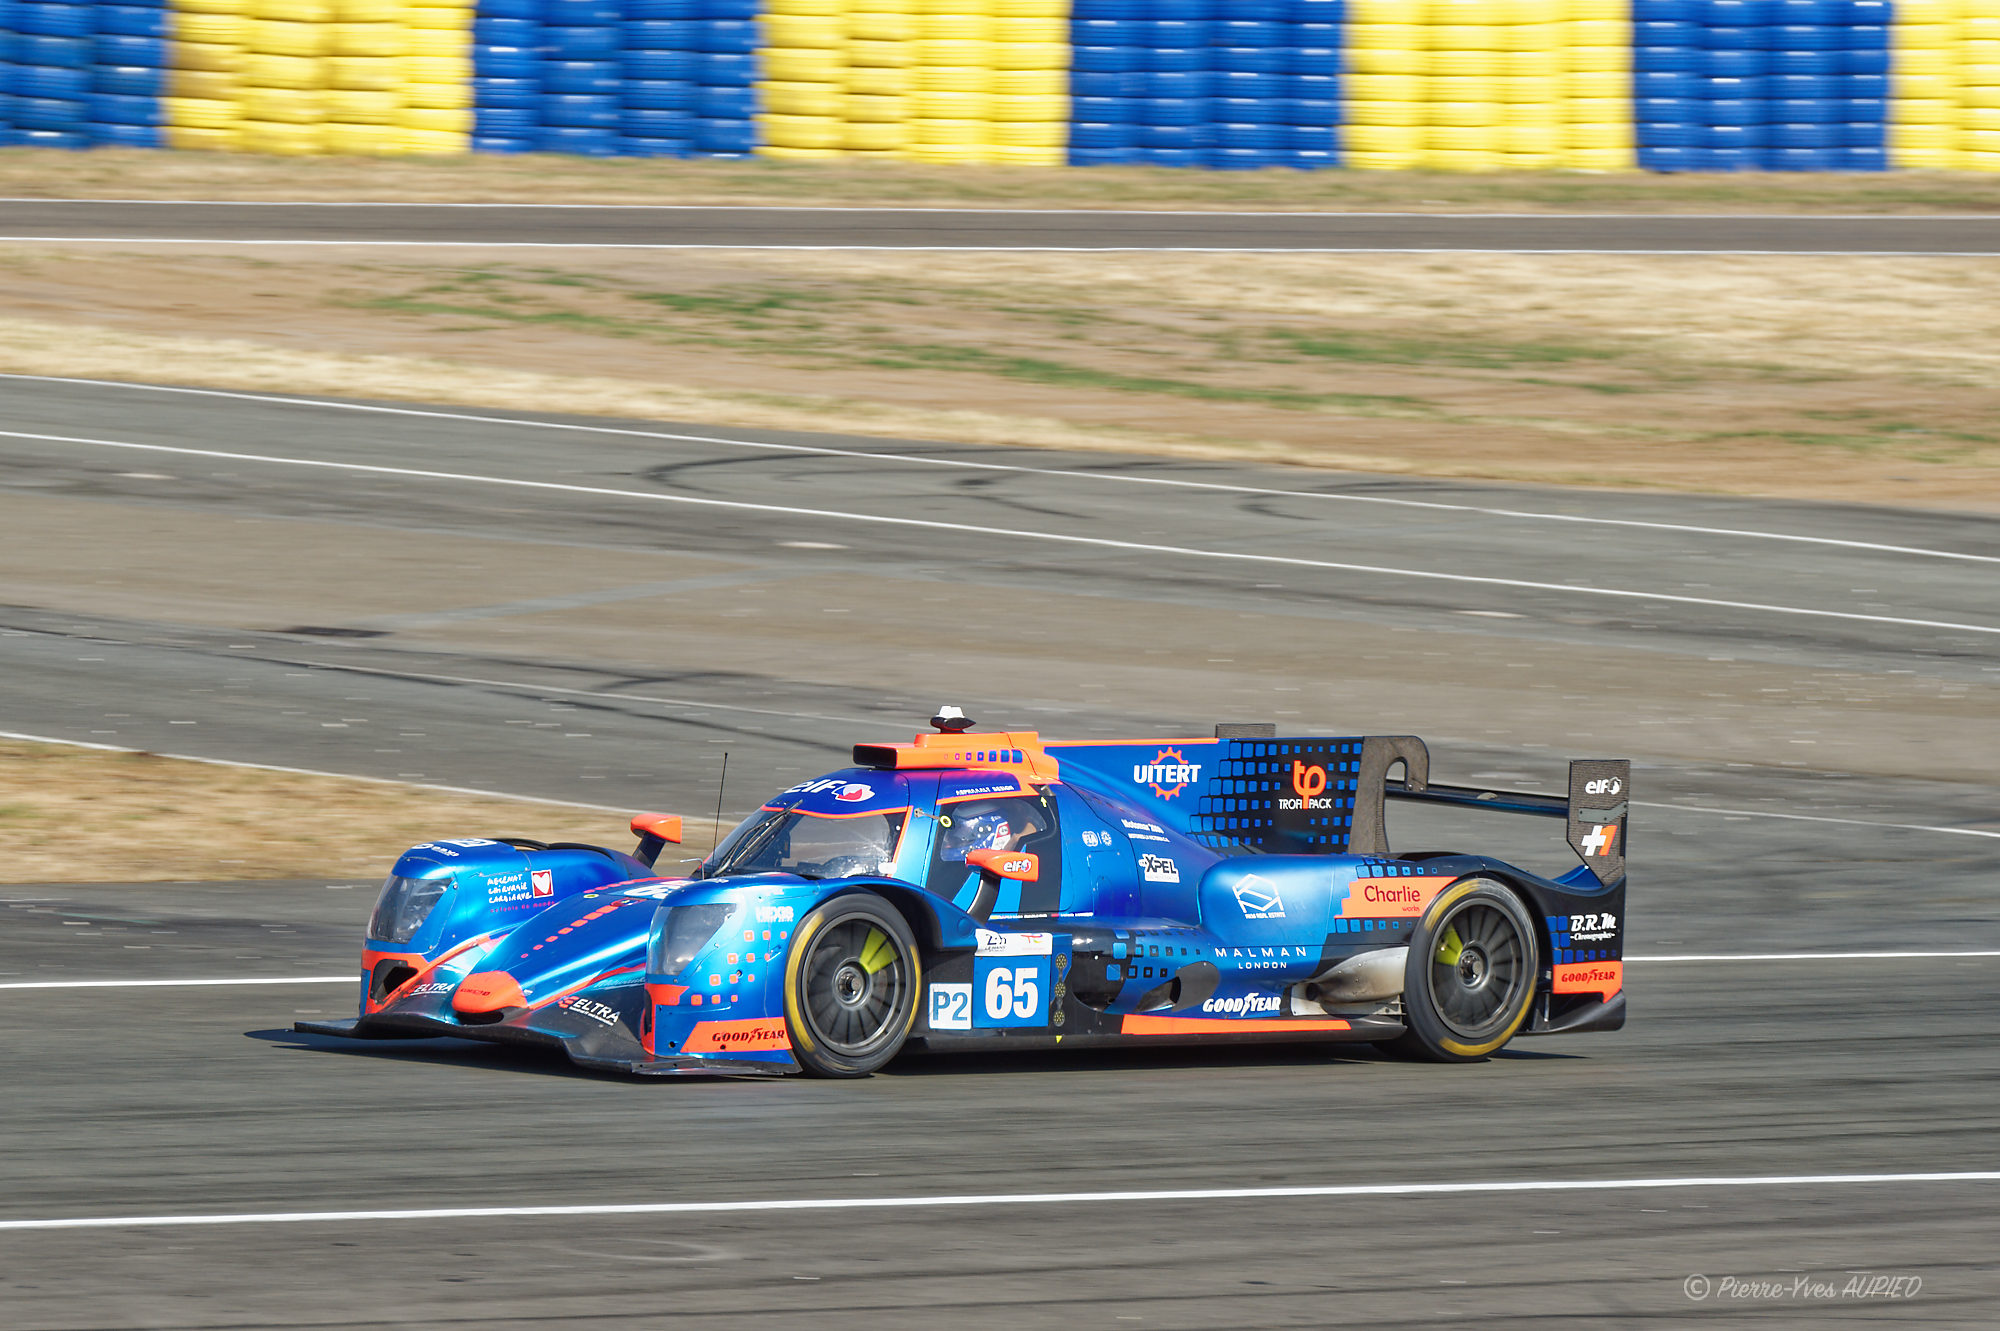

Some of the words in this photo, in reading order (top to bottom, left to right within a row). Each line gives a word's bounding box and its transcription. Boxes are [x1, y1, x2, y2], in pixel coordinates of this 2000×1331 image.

[1134, 765, 1202, 783] UITERT
[784, 779, 847, 793] elf
[1585, 779, 1611, 794] elf
[1581, 825, 1618, 857] +1
[1003, 859, 1022, 872] elf
[1145, 856, 1177, 874] XPEL
[1364, 885, 1421, 902] Charlie
[1215, 947, 1307, 958] MALMAN
[1561, 968, 1615, 984] GOODYEAR
[415, 983, 455, 992] ELTRA
[985, 967, 1038, 1019] 65
[572, 998, 620, 1022] ELTRA
[932, 991, 968, 1021] P2
[1203, 993, 1281, 1016] GOODYEAR
[712, 1028, 784, 1043] GOODYEAR
